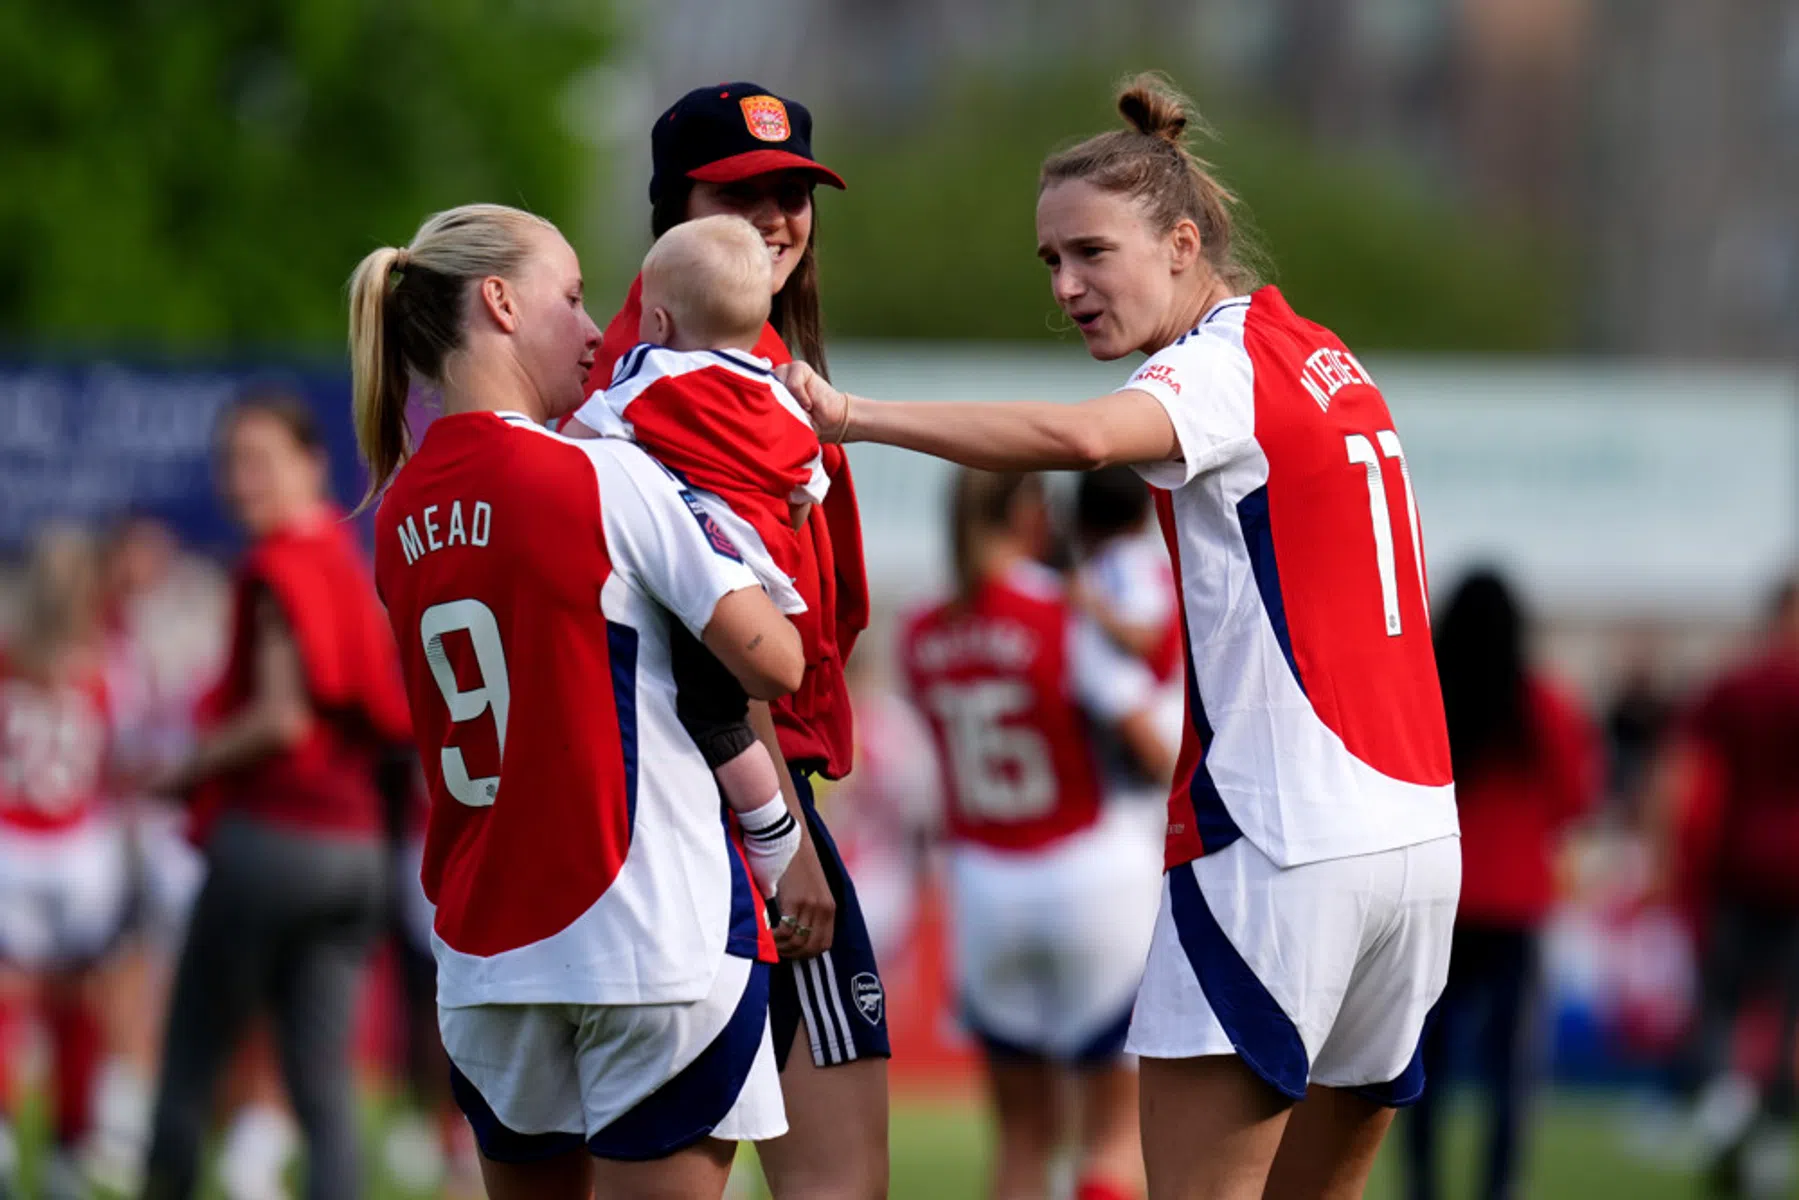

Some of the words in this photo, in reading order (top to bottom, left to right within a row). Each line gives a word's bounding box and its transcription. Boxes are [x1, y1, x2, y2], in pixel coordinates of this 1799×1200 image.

[397, 500, 492, 566] MEAD
[1344, 430, 1430, 636] 11
[420, 598, 511, 807] 9
